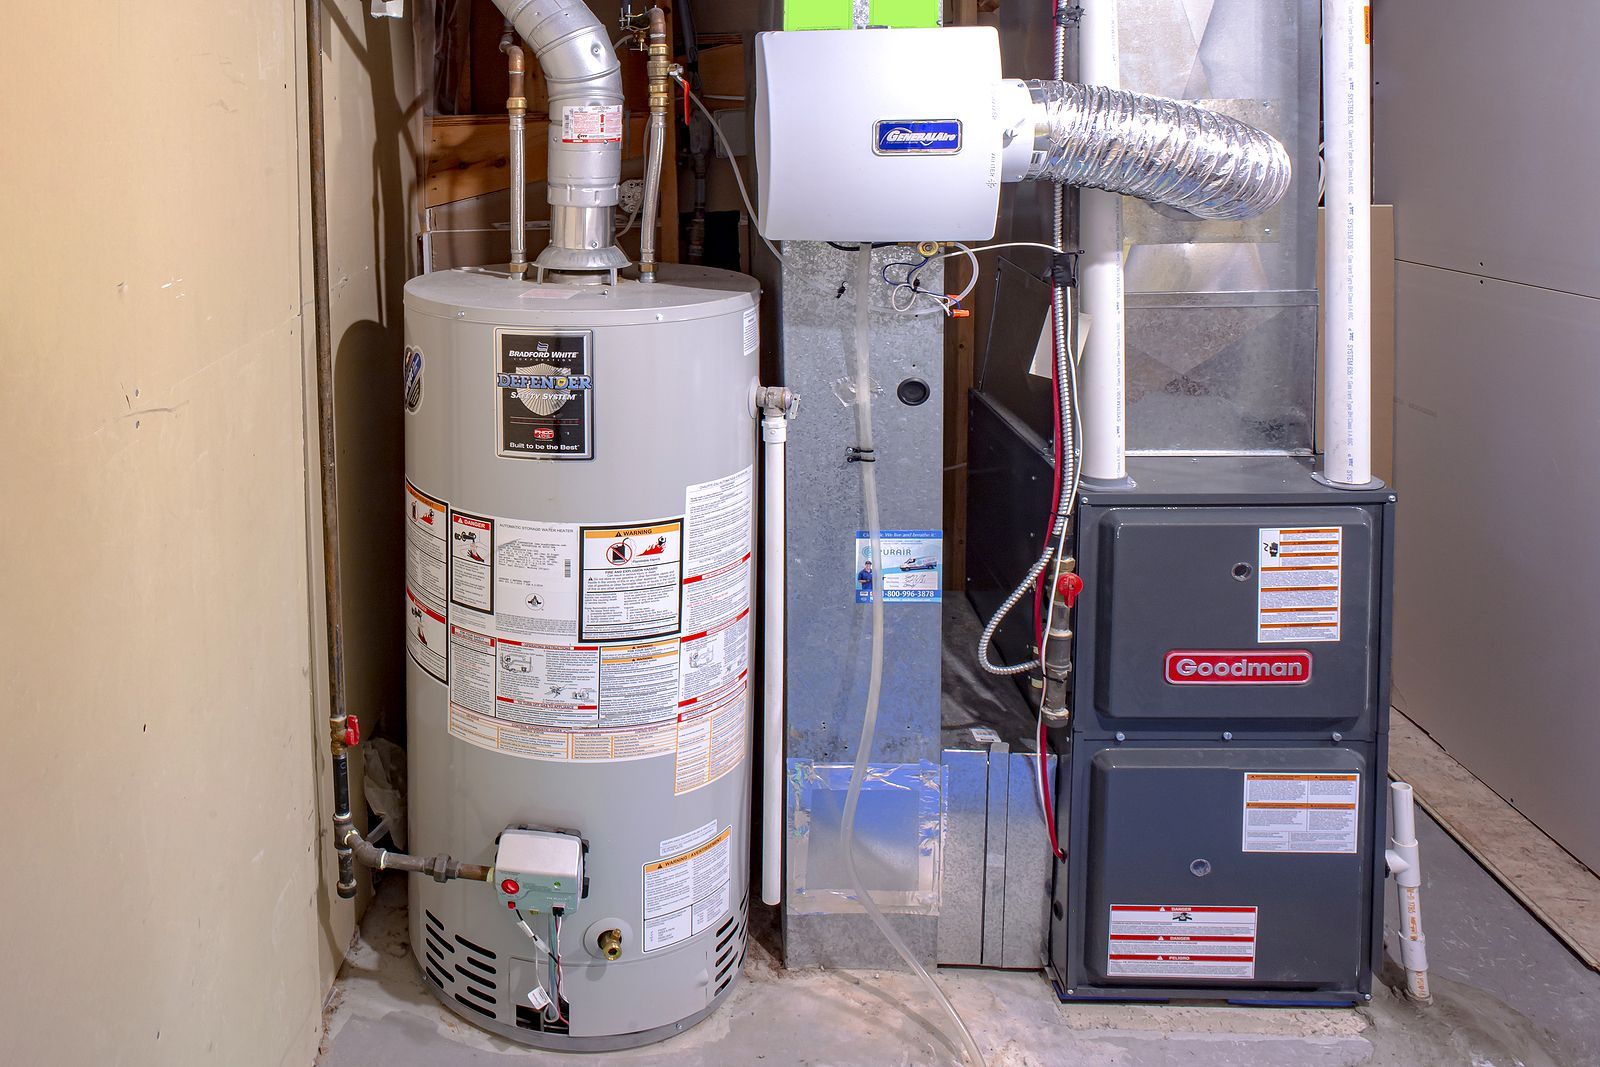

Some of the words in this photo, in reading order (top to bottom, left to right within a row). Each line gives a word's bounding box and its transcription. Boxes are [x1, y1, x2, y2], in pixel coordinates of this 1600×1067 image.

[509, 350, 550, 358] BRADFORD
[551, 351, 578, 359] WHITE
[498, 373, 592, 389] DEFENDER
[542, 393, 575, 401] SYSTEM
[463, 520, 486, 529] DANGER
[624, 529, 652, 537] WARNING
[1175, 659, 1302, 677] Goodman
[665, 856, 688, 866] WARNING
